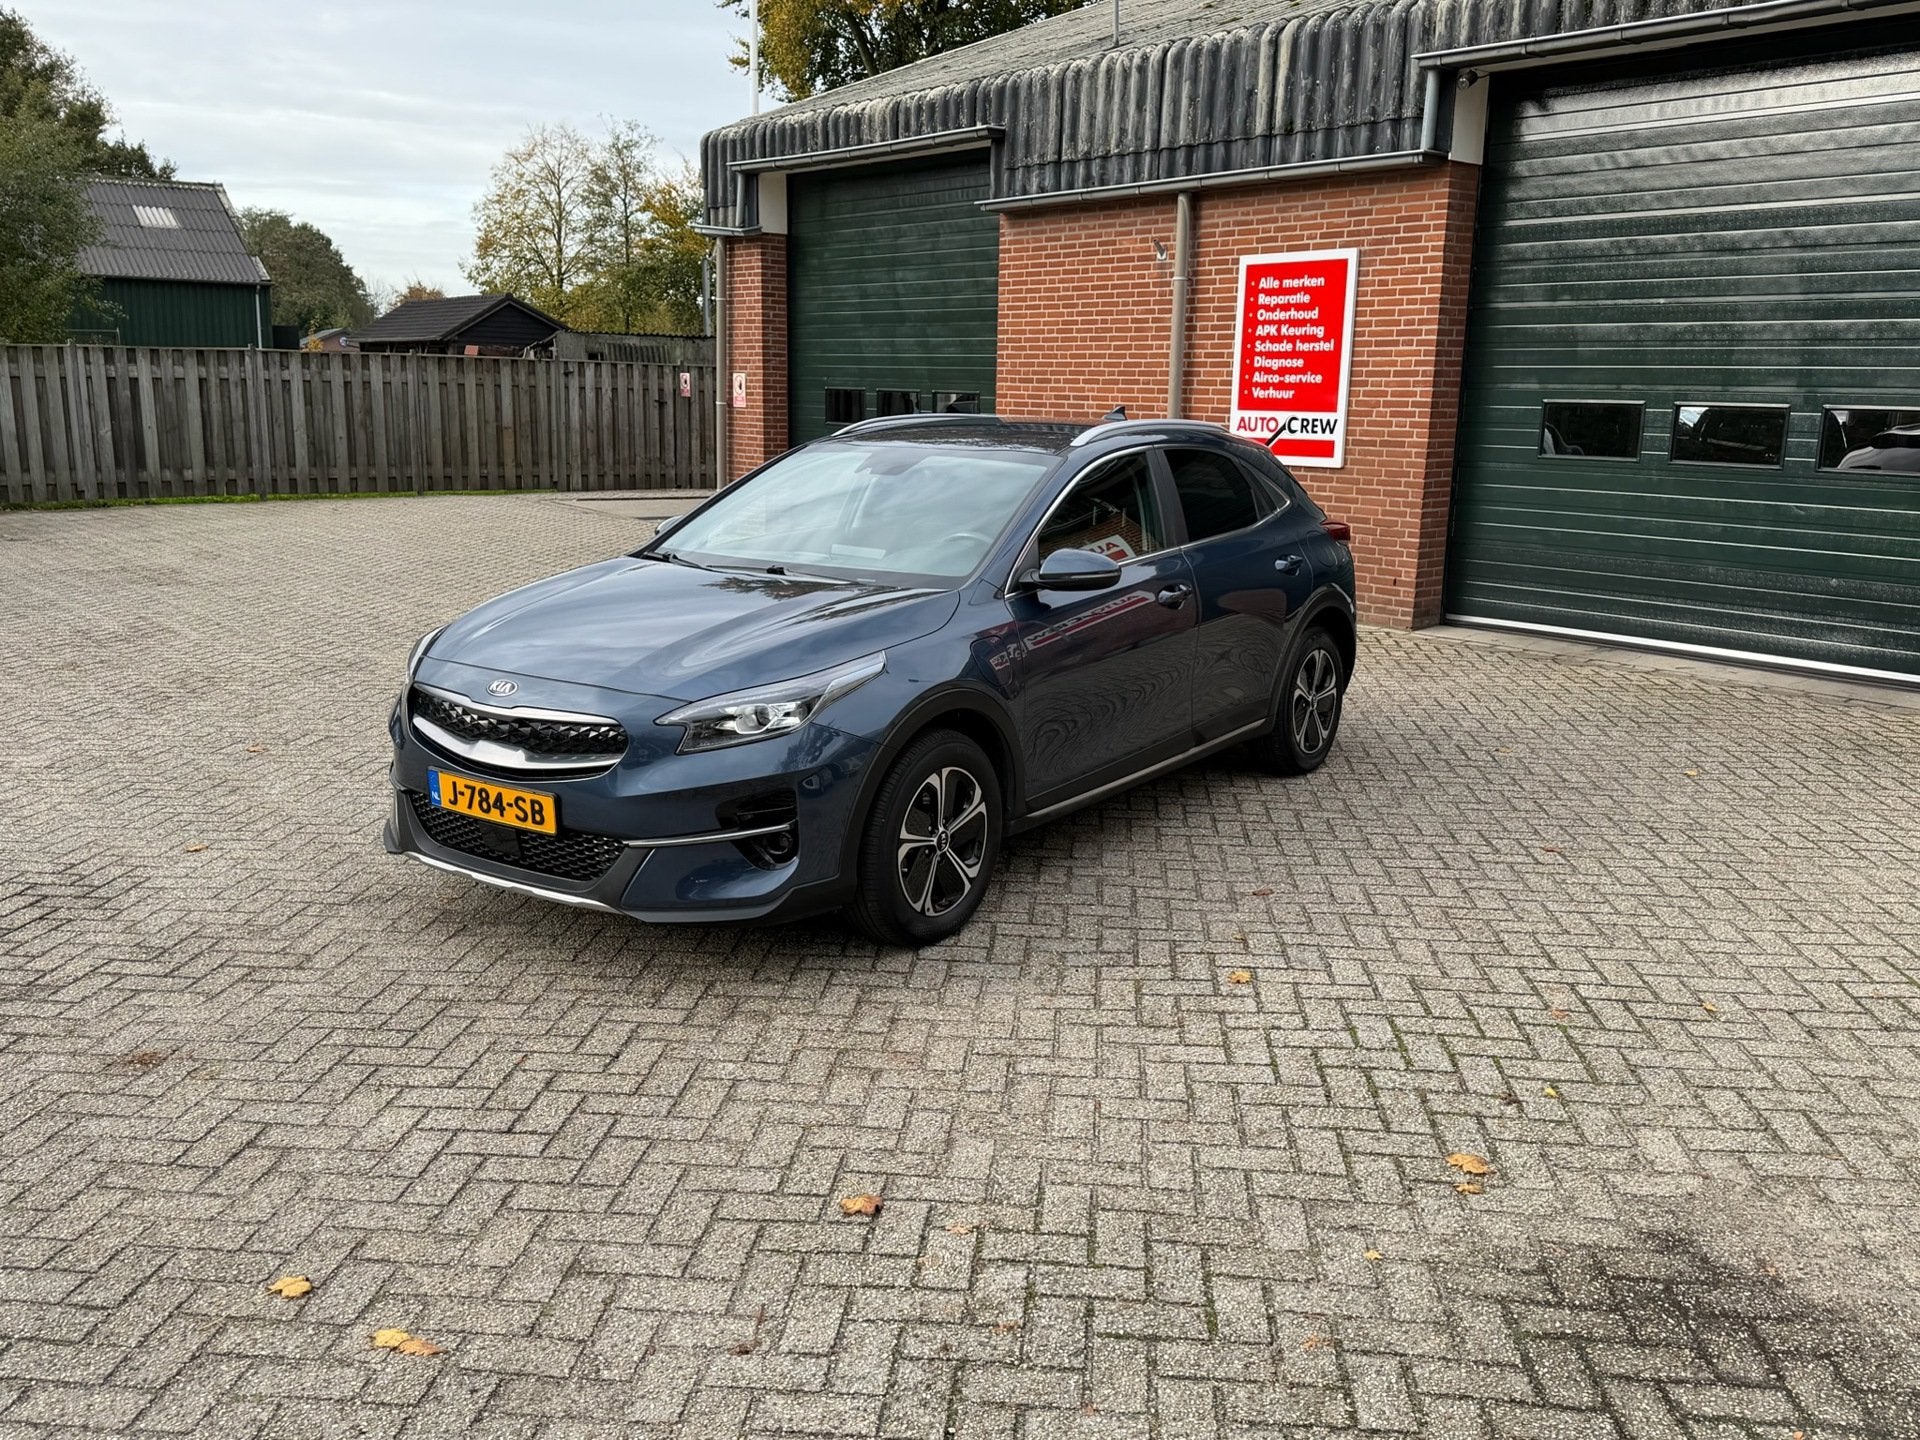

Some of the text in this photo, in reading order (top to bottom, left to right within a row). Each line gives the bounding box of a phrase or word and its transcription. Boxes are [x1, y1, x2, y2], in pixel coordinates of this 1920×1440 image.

[1259, 275, 1325, 289] Alle merken
[1258, 292, 1311, 307] Reparatie
[1257, 307, 1319, 321] Onderhoud
[1255, 323, 1325, 338] APK Keuring
[1254, 338, 1335, 352] Schade herstel
[1253, 356, 1305, 370] Diagnose
[1252, 371, 1323, 383] Airco-service
[1252, 387, 1295, 399] Verhuur
[1237, 416, 1338, 435] AUTO CREW
[490, 680, 512, 692] KIA
[432, 791, 440, 800] NL
[448, 780, 546, 826] J-784-SB
